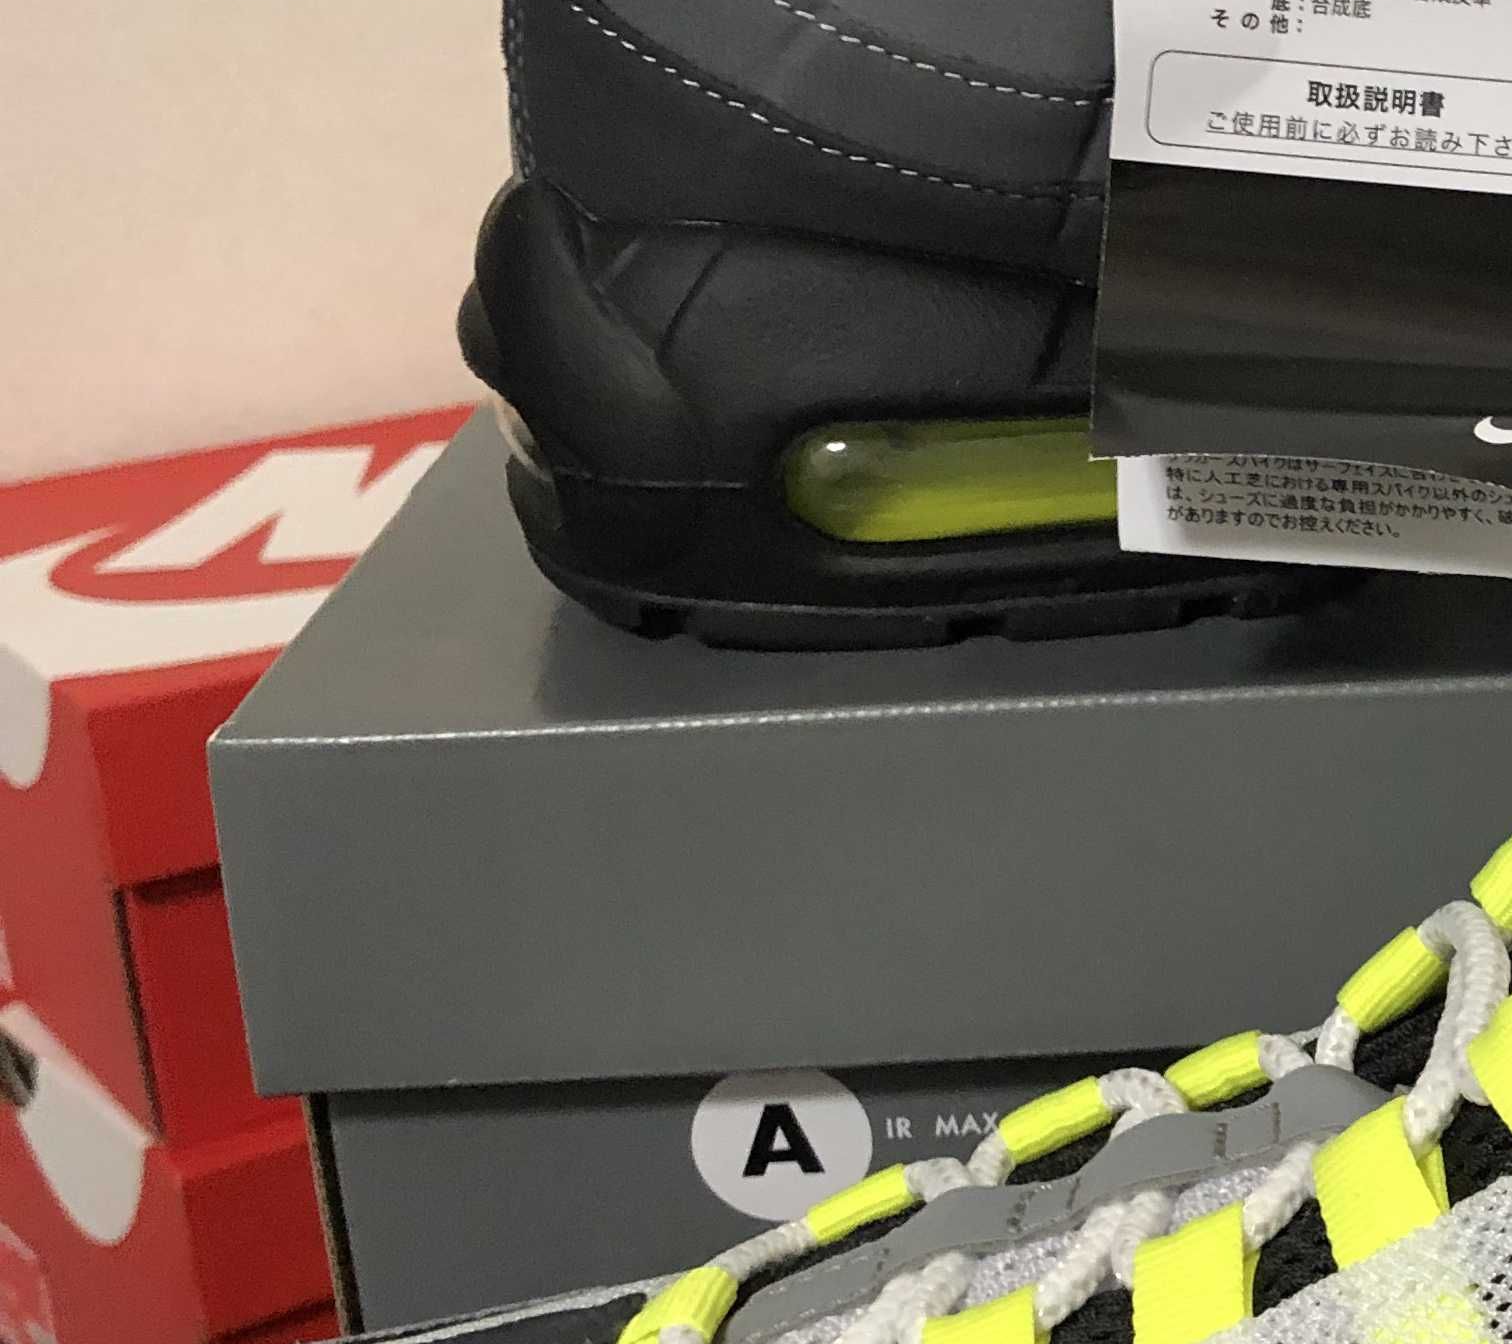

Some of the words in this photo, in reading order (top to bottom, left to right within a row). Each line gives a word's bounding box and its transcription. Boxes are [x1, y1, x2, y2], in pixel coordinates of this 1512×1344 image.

[1307, 80, 1446, 118] 取扱説明書
[935, 1112, 999, 1138] MAX
